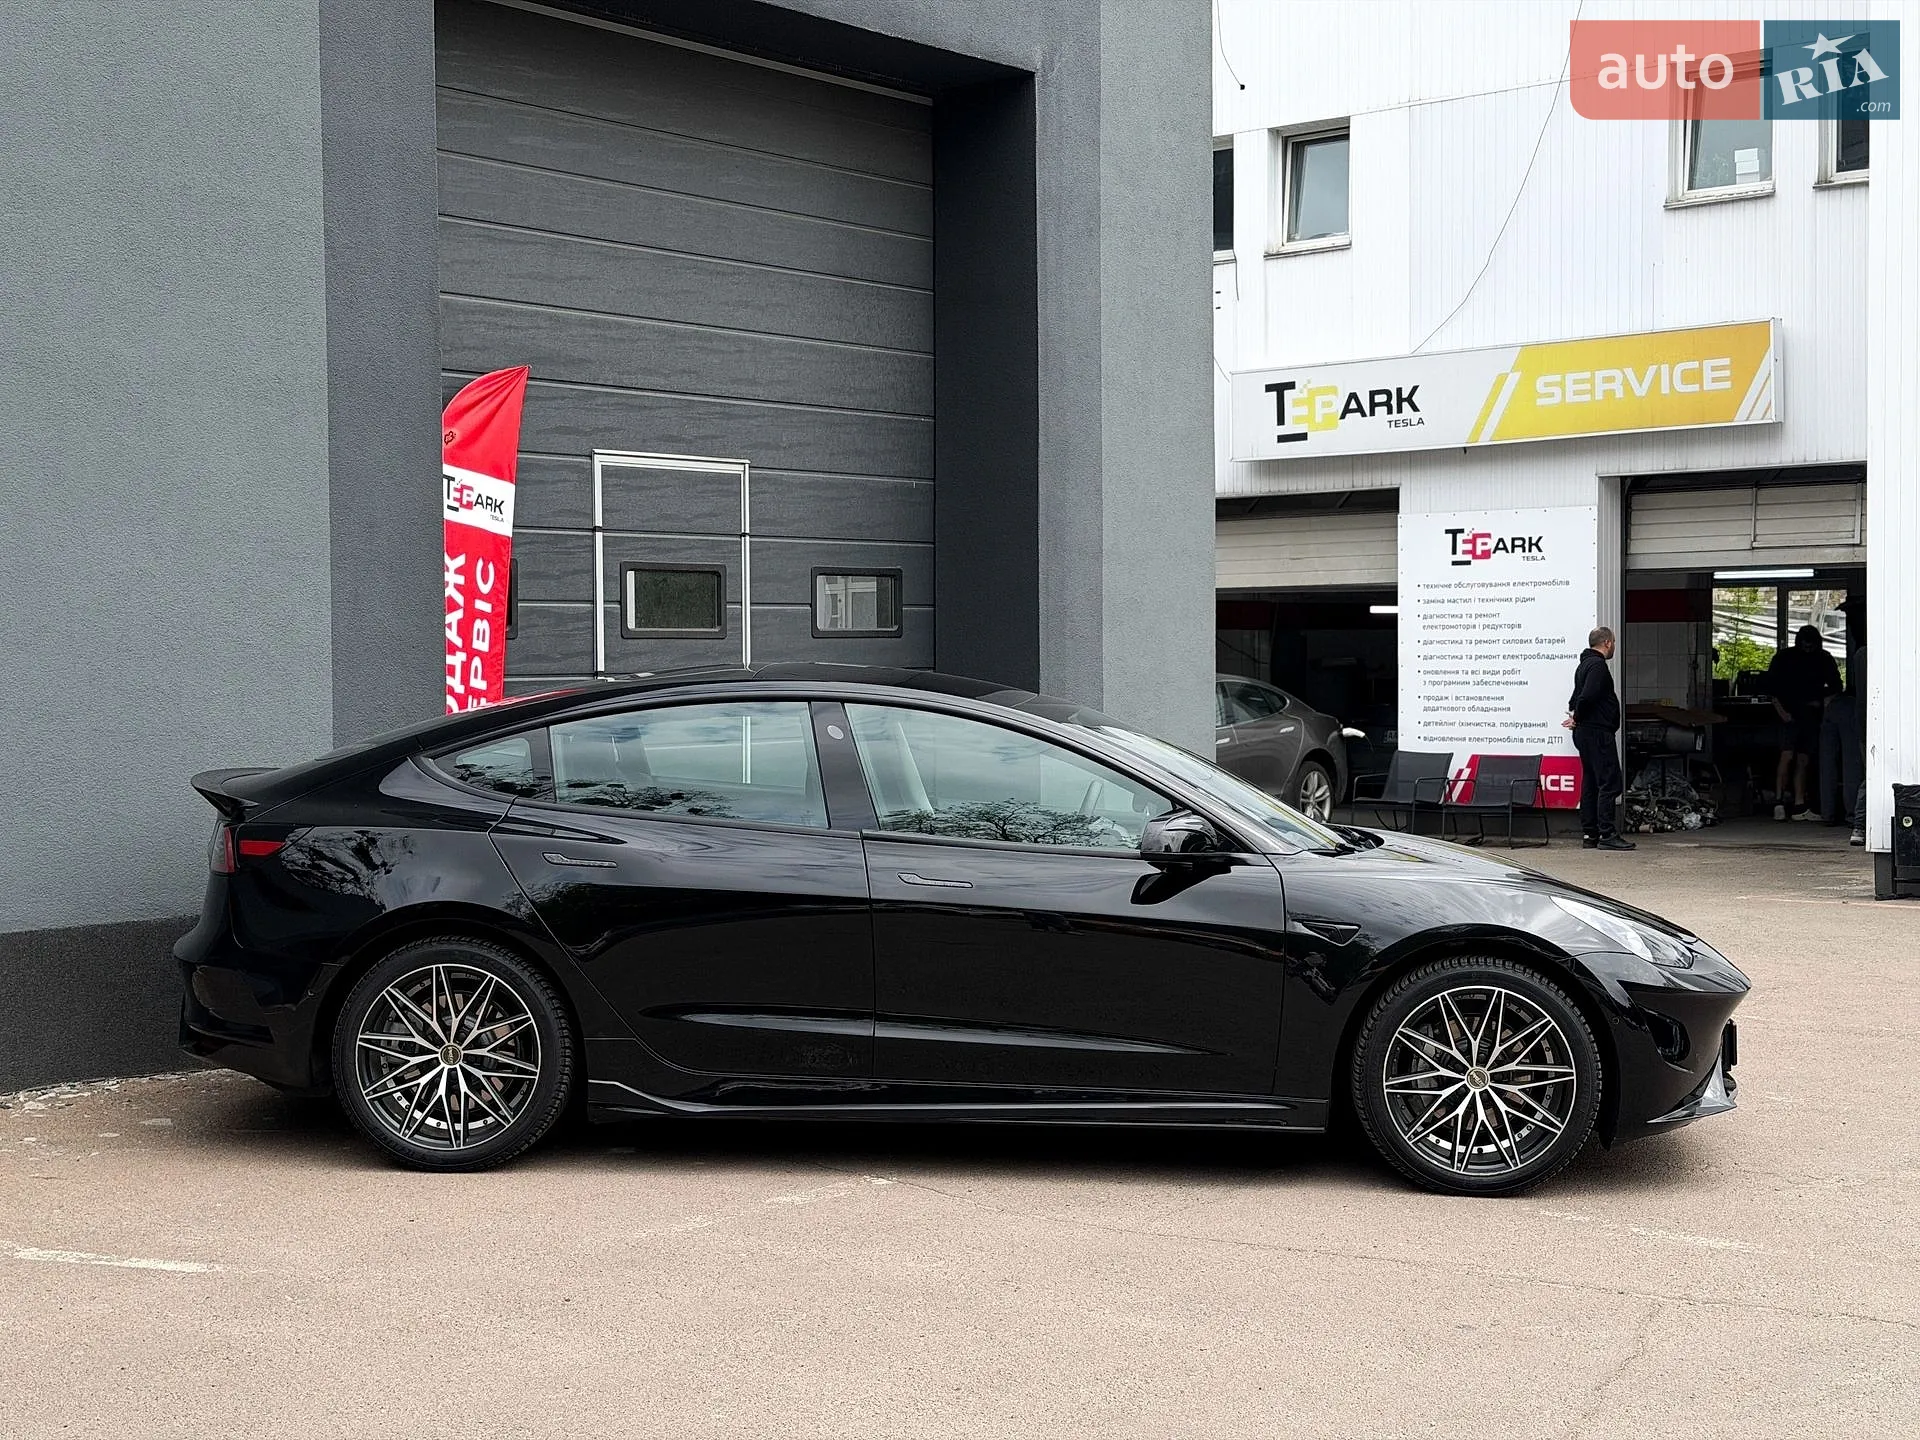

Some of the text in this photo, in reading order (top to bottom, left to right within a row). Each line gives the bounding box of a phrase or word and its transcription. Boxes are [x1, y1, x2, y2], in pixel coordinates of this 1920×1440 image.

[1536, 358, 1731, 406] SERVICE
[1387, 417, 1425, 429] TESLA
[490, 514, 504, 523] TESLA
[1423, 579, 1570, 590] технічне обслуговування електромобілів
[1515, 596, 1535, 604] рідин
[1423, 612, 1463, 620] діагностика
[1475, 612, 1500, 620] ремонт
[1423, 623, 1476, 631] електромоторів
[1483, 623, 1522, 631] редукторів
[1423, 638, 1463, 646] діагностика
[1475, 638, 1500, 646] ремонт
[1535, 637, 1566, 646] батарей
[1423, 653, 1463, 661] діагностика
[1475, 653, 1500, 661] ремонт
[1503, 652, 1577, 660] електрообладнання
[1503, 668, 1521, 676] робіт
[1472, 679, 1528, 687] забеспеченням
[1468, 705, 1511, 713] обладнання
[1458, 721, 1496, 729] (хімчистка,
[1499, 721, 1548, 729] полірування)
[1468, 736, 1524, 745] електромобілів
[1526, 736, 1545, 744] після
